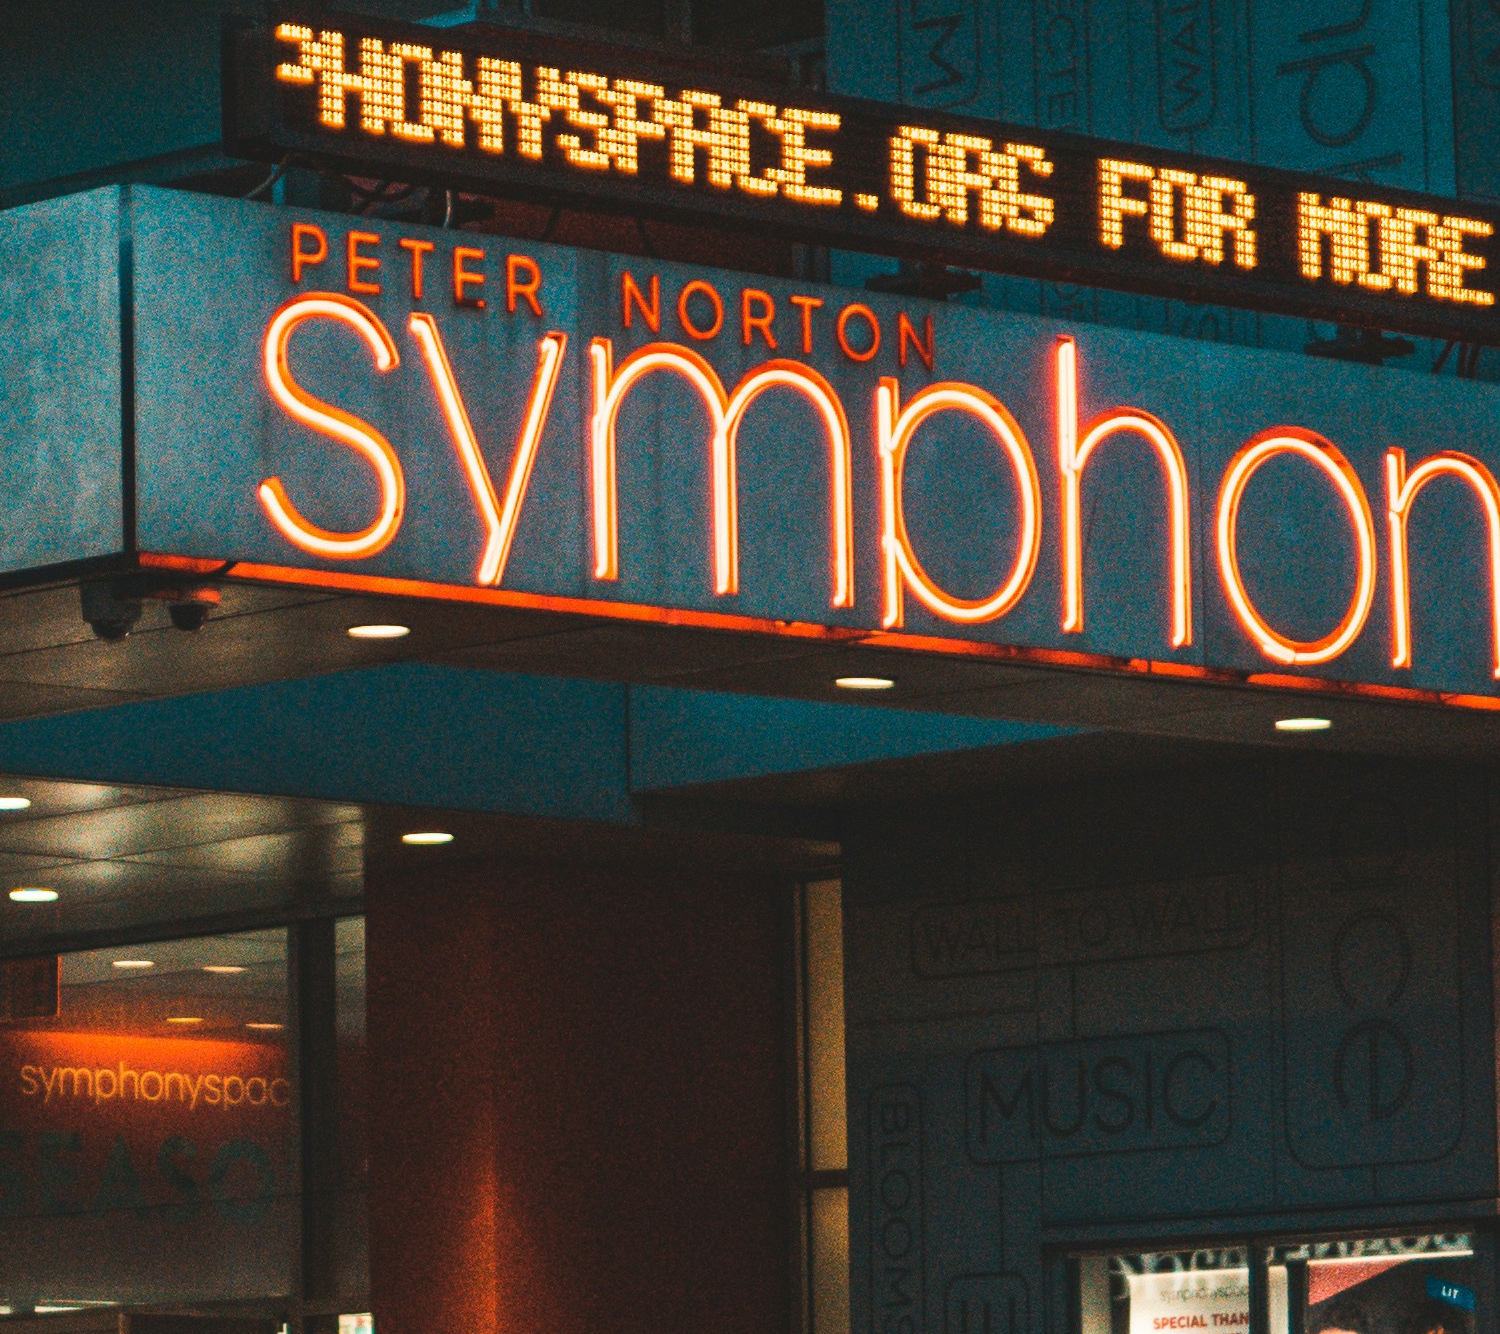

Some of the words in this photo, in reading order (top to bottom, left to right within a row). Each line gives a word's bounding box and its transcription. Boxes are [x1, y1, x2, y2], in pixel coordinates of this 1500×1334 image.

[1095, 157, 1258, 270] FOR
[1296, 191, 1497, 307] MORE
[290, 221, 546, 319] PETER
[620, 269, 938, 372] NORTON
[19, 1058, 291, 1113] symphonyspac
[973, 1049, 1221, 1147] MUSIC
[1153, 1315, 1208, 1331] SPECIAL
[1211, 1312, 1250, 1328] THAN
[1441, 1285, 1460, 1300] LIT
